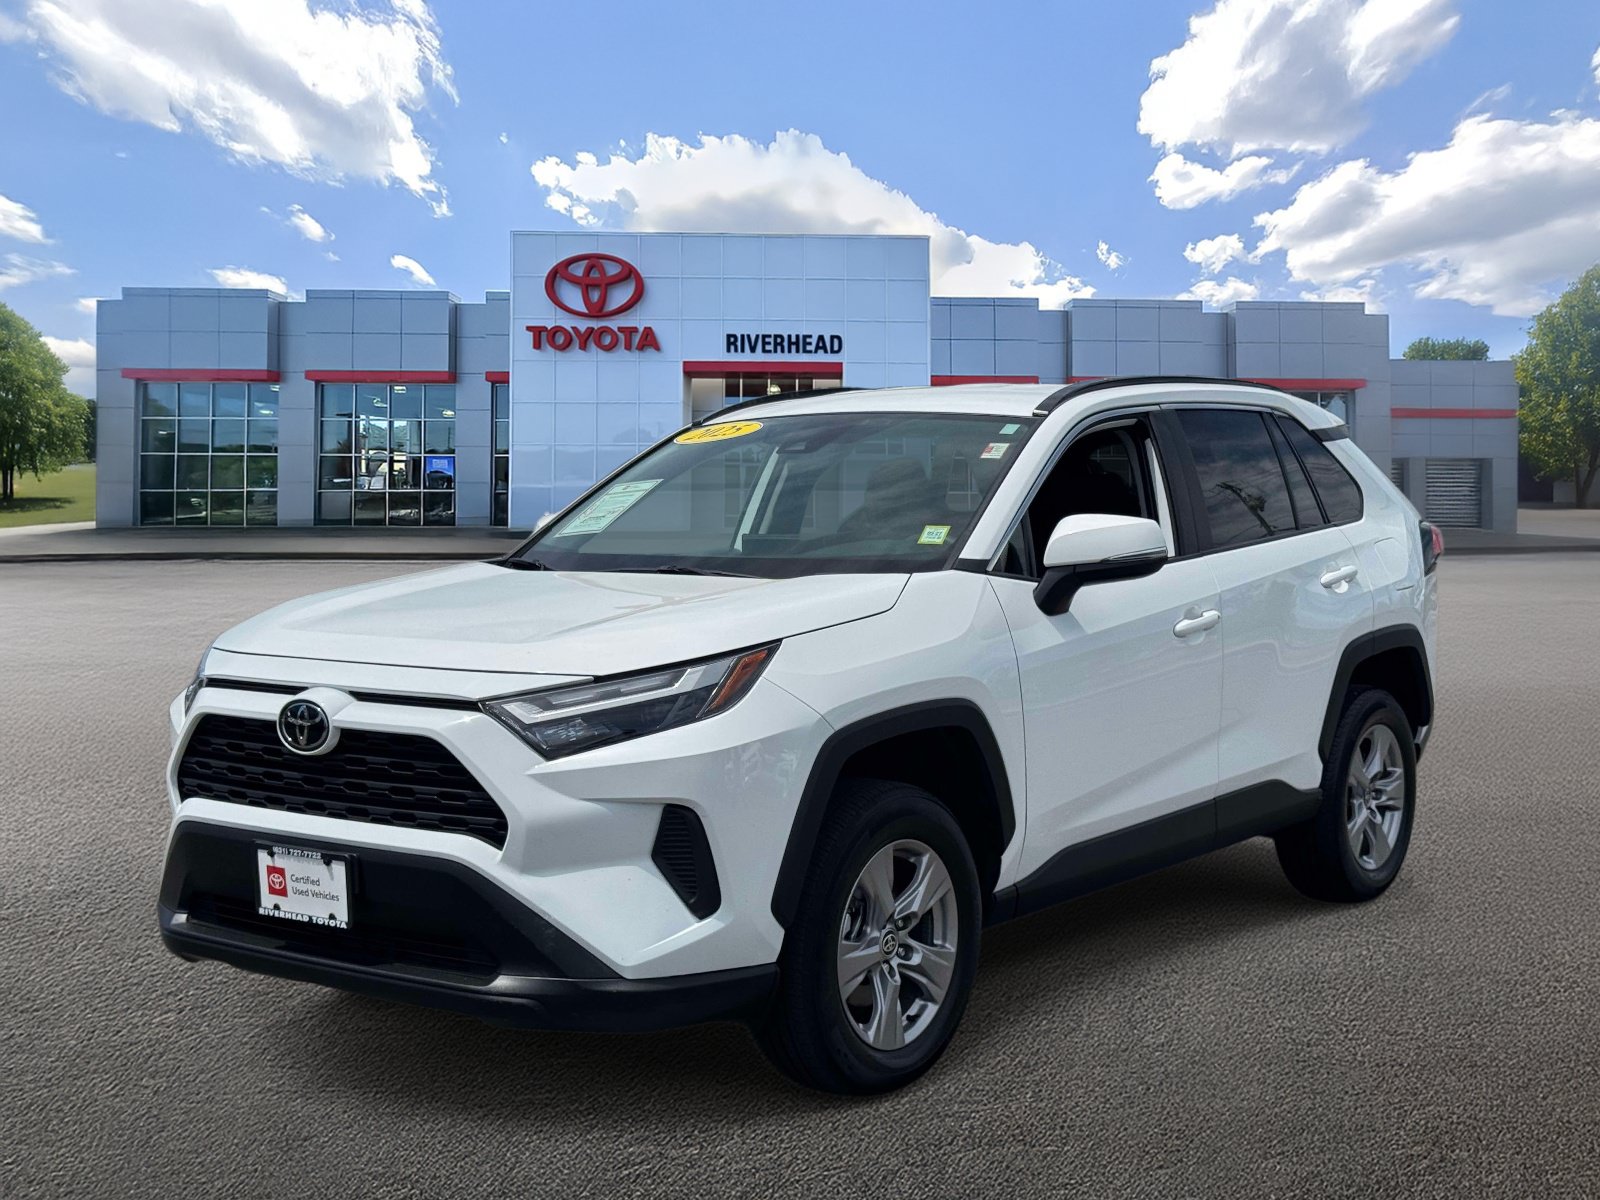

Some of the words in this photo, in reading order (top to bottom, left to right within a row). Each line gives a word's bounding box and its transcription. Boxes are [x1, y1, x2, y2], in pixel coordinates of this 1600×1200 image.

[526, 326, 660, 351] TOYOTA
[725, 334, 843, 354] RIVERHEAD
[290, 874, 320, 886] Certified
[292, 887, 309, 897] Used
[310, 889, 340, 901] Vehicles
[259, 907, 310, 922] RIVERHEAD
[312, 917, 347, 929] TOYOTA
